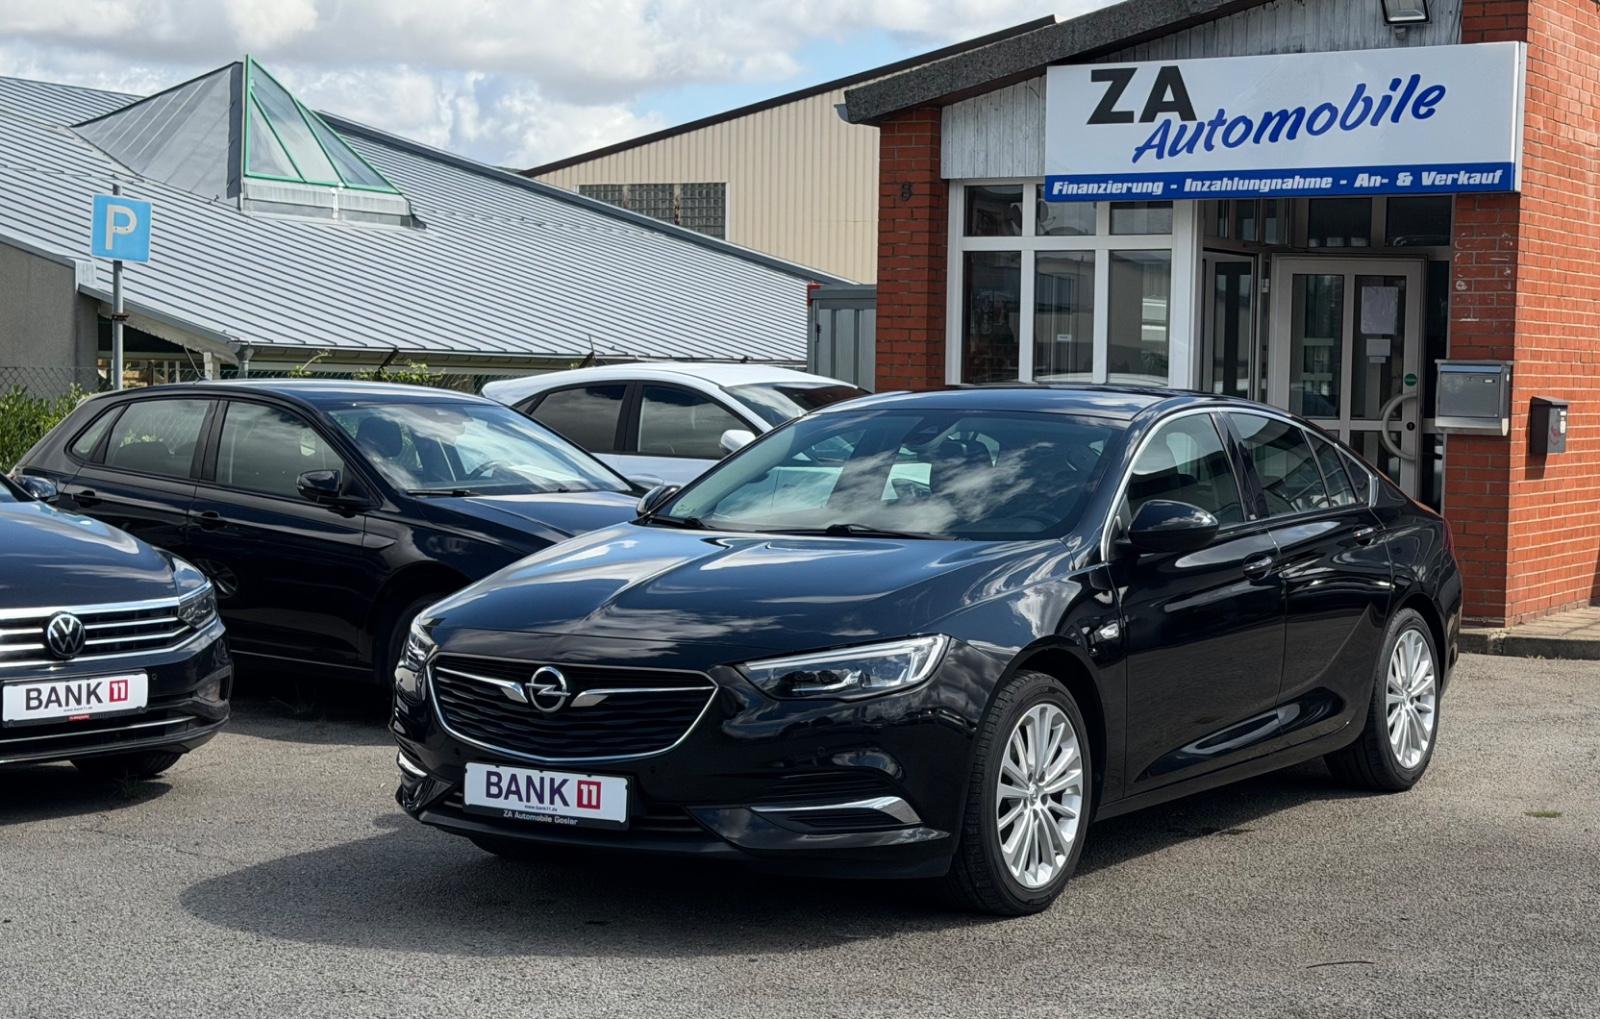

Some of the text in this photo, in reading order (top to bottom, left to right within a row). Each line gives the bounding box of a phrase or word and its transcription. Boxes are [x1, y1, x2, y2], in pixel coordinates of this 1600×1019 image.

[1086, 65, 1197, 125] ZA
[1132, 74, 1446, 164] Automobile
[1052, 180, 1164, 195] Finanzierung
[1183, 175, 1333, 193] Inzahlungnahme
[1354, 173, 1389, 188] An-
[1396, 172, 1413, 186] &
[1421, 169, 1504, 186] Verkauf
[105, 204, 137, 250] P
[25, 680, 128, 711] BANK 11
[485, 770, 600, 807] BANK 11
[503, 809, 513, 818] ZA
[514, 811, 553, 823] Automobile
